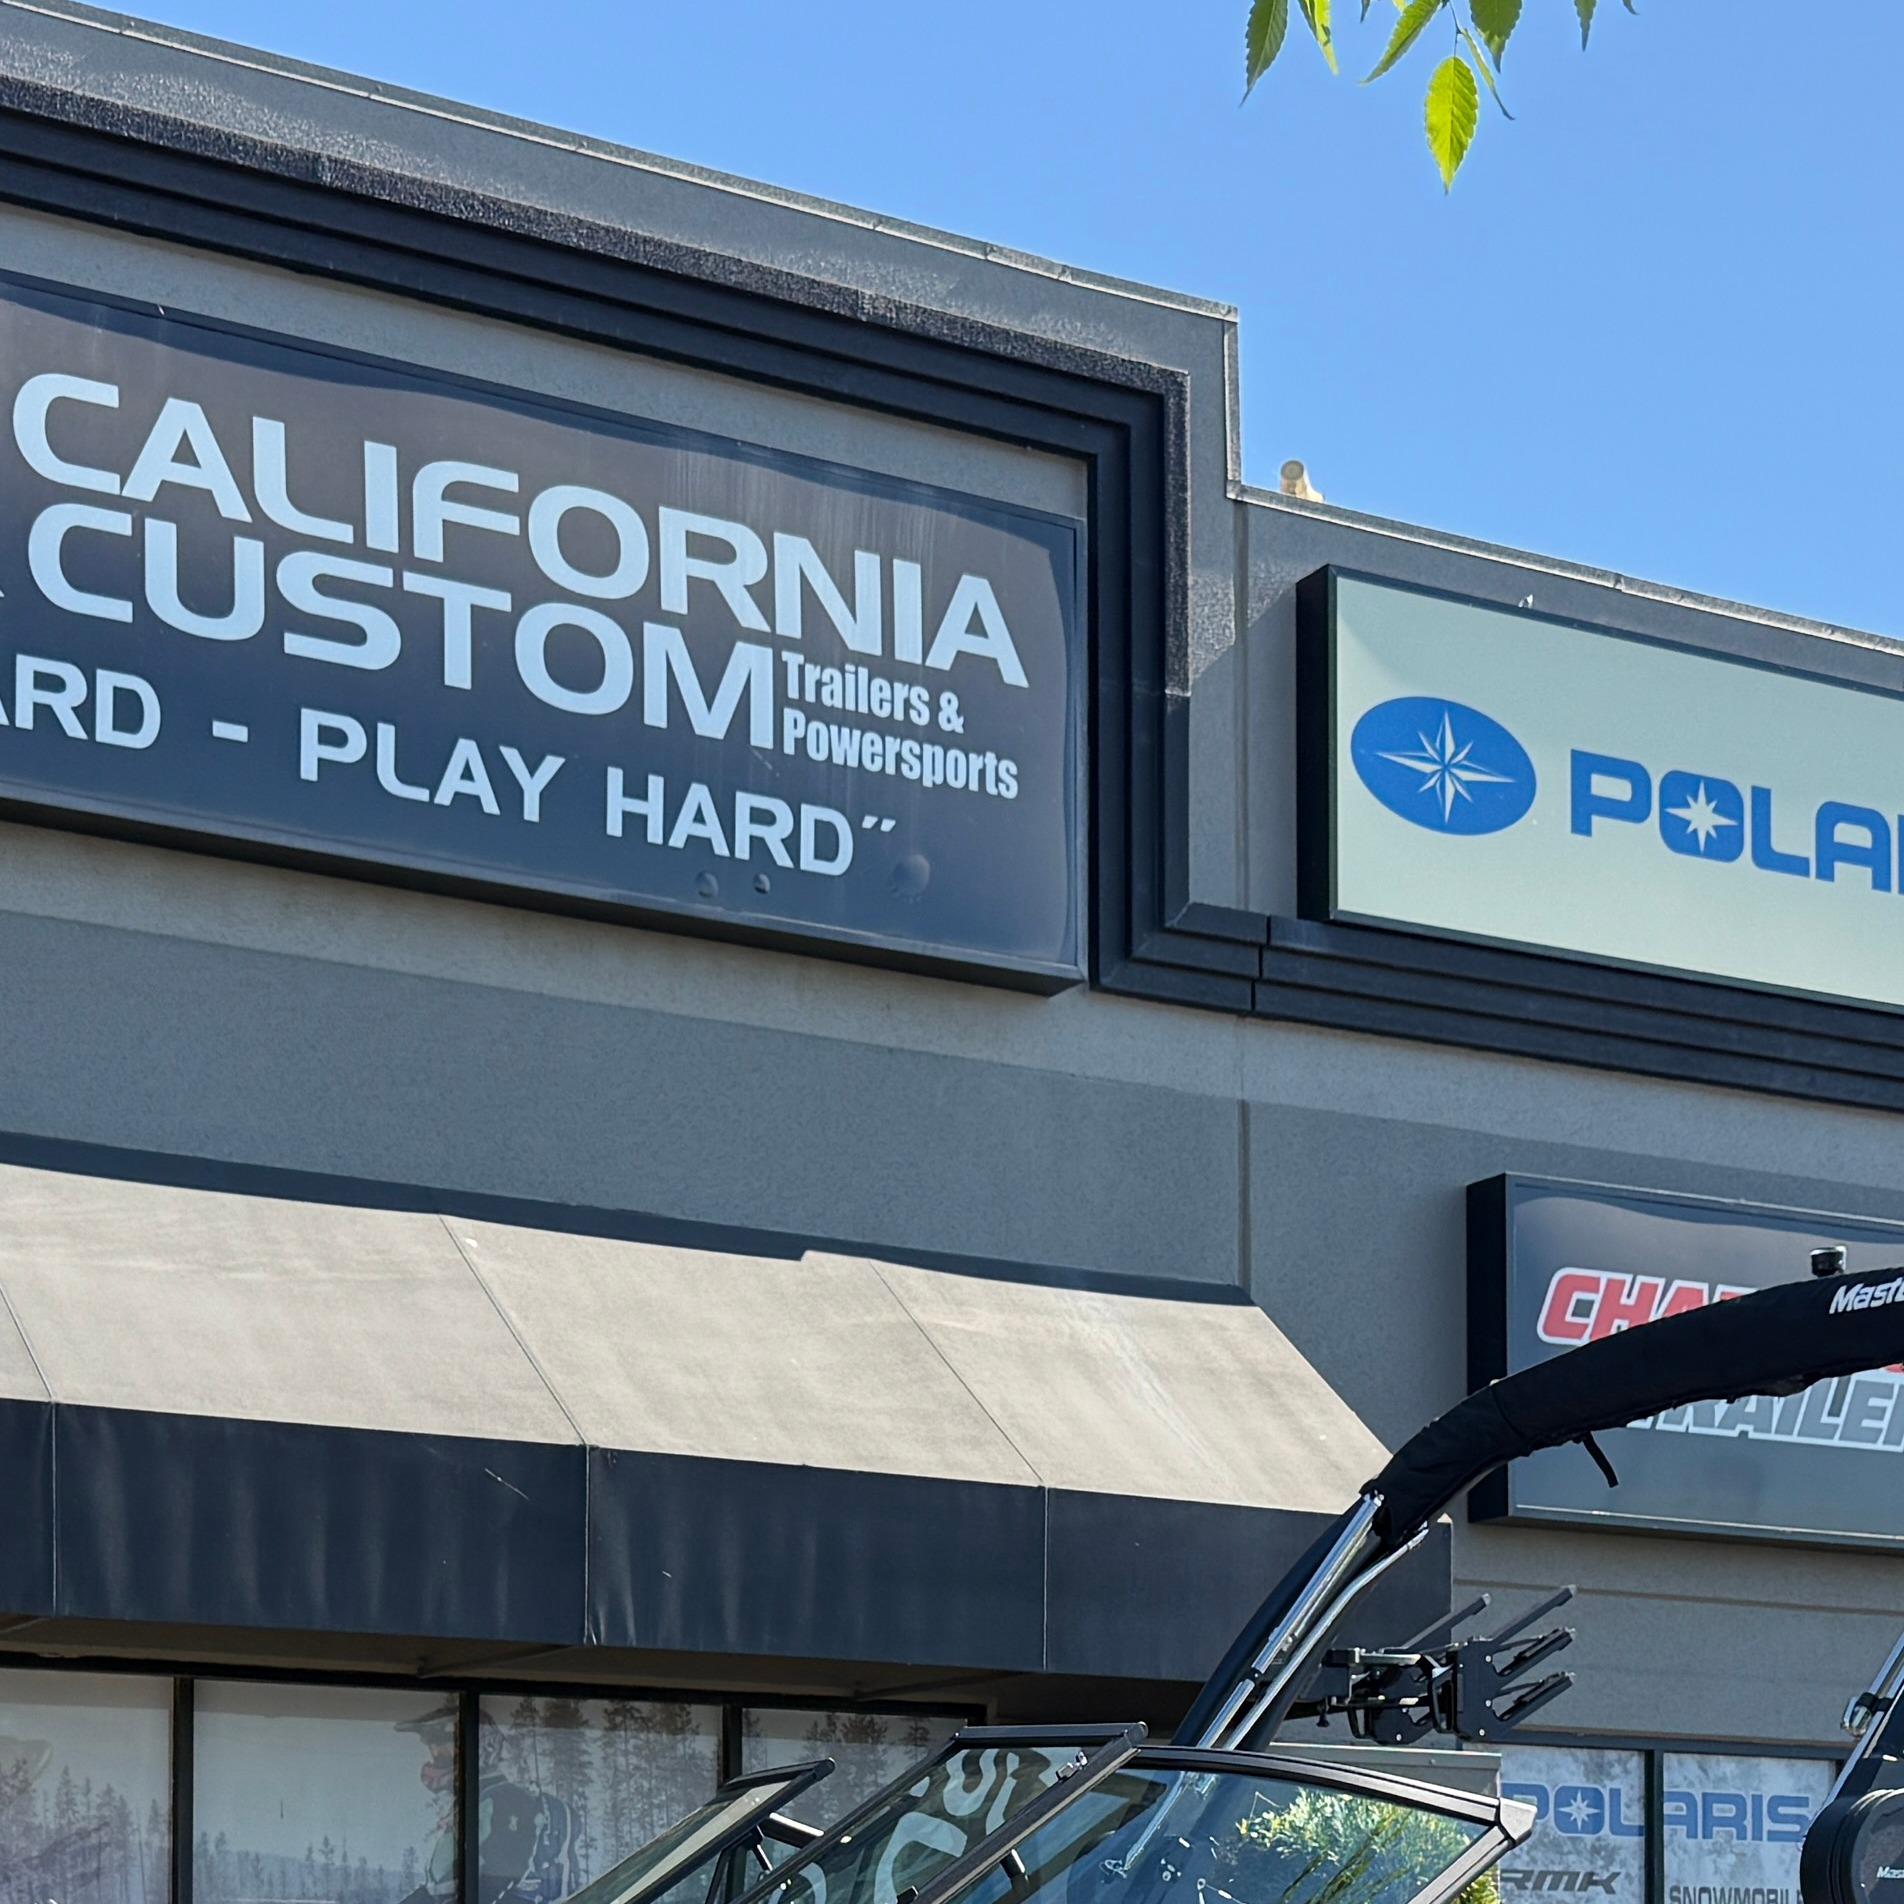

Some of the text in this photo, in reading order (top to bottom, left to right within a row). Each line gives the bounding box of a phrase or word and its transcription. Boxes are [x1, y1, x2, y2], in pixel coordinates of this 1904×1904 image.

[12, 372, 1030, 689] CALIFORNIA
[27, 501, 774, 750] CUSTOM
[782, 648, 965, 735] Trailers &
[211, 719, 248, 743] -
[300, 708, 566, 824] PLAY
[782, 706, 1019, 801] Powersports
[1498, 1781, 1812, 1844] POLARIS
